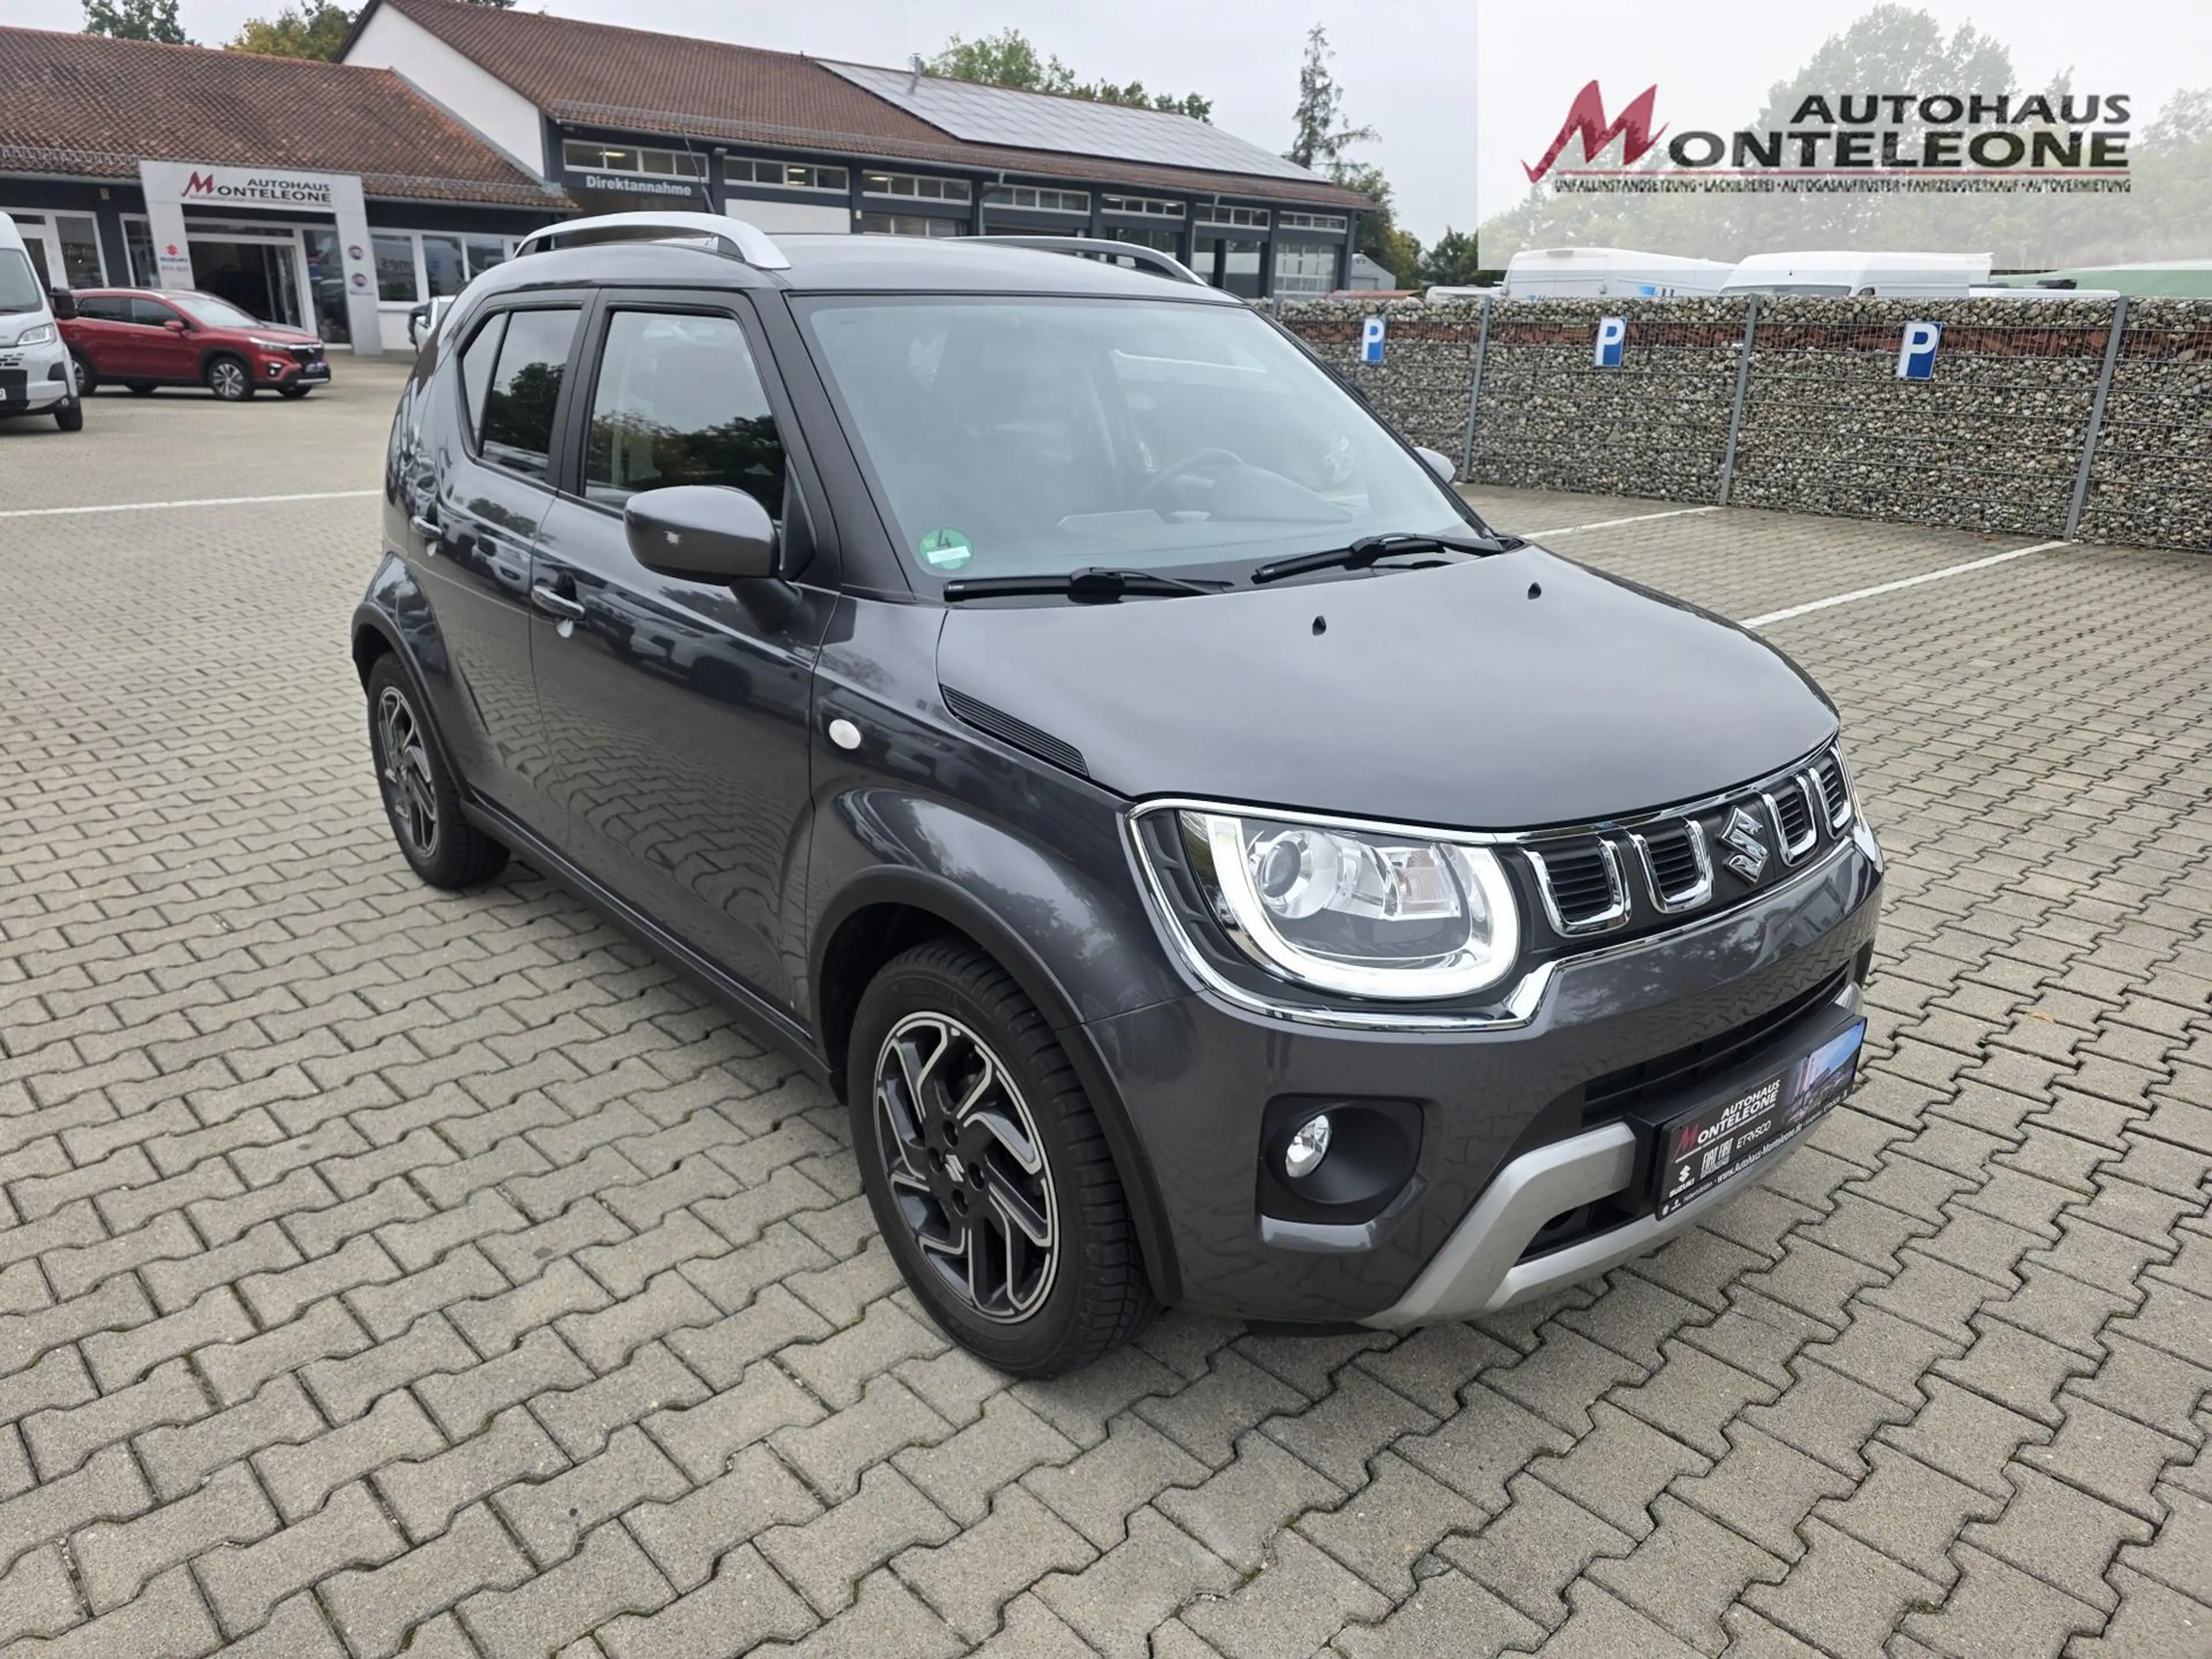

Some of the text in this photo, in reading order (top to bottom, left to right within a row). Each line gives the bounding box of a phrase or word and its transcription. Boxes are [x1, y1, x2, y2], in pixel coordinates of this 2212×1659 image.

[181, 171, 332, 202] MONTELEONE
[247, 178, 330, 192] AUTOHAUS
[586, 175, 692, 196] Direktannahme
[1361, 318, 1385, 361] P
[1595, 318, 1625, 366] P
[1897, 322, 1938, 377] P
[1721, 1079, 1781, 1121] AUTOHAUS
[1672, 1090, 1779, 1164] MONTELEONE
